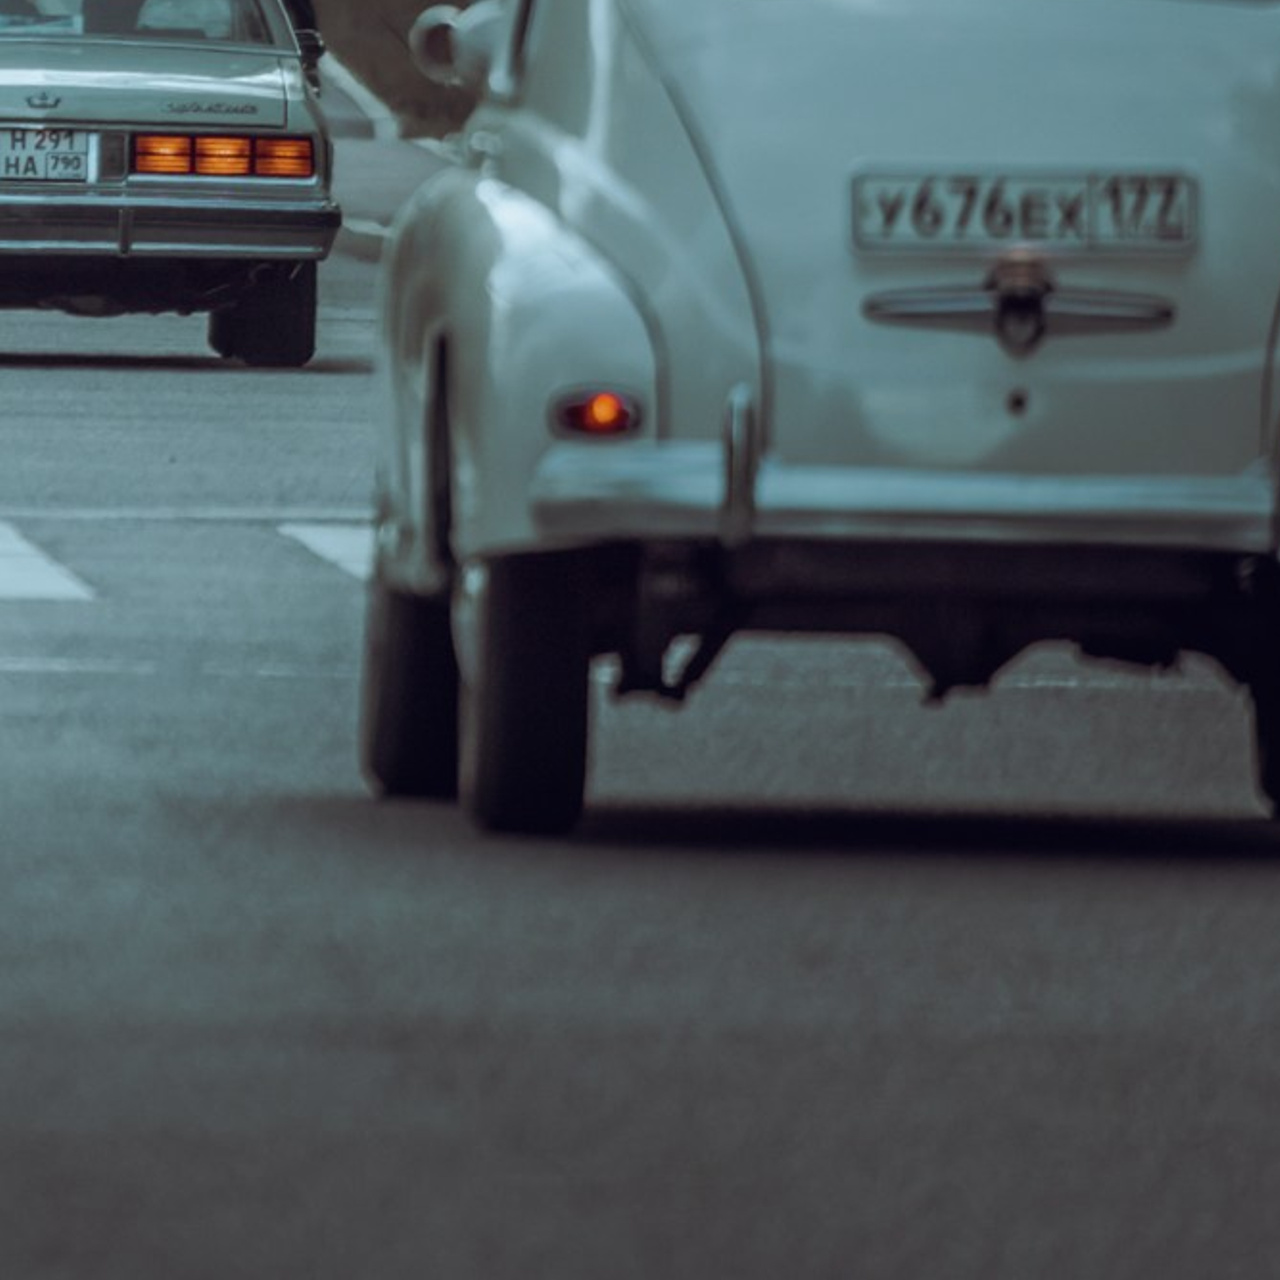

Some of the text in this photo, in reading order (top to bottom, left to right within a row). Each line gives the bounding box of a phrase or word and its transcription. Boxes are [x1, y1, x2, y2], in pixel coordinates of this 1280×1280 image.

[34, 131, 74, 150] 291
[4, 155, 80, 175] НА 790
